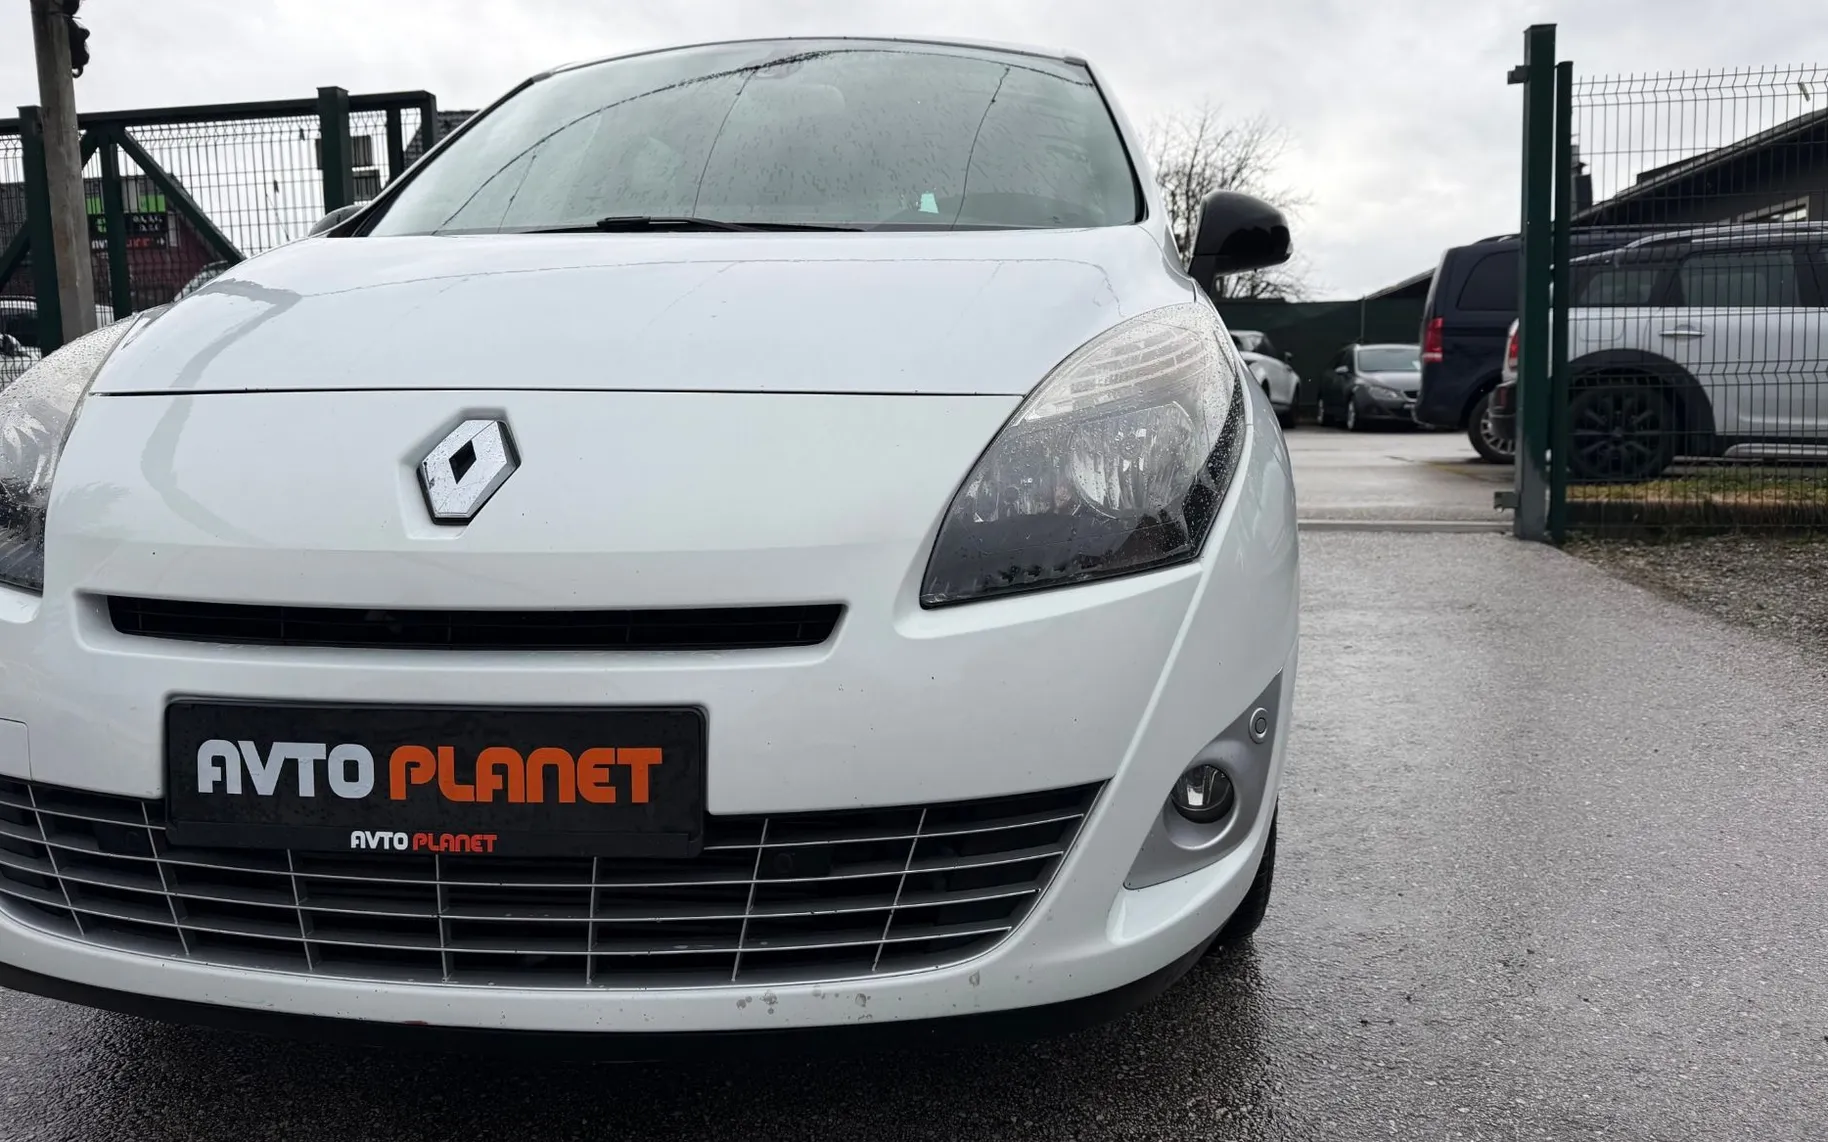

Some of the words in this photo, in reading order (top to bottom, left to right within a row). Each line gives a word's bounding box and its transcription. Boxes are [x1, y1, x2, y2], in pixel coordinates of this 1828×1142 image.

[197, 738, 375, 799] AVTO
[389, 745, 664, 804] PLANET
[350, 830, 409, 851] AVTO
[413, 832, 498, 853] PLANET
